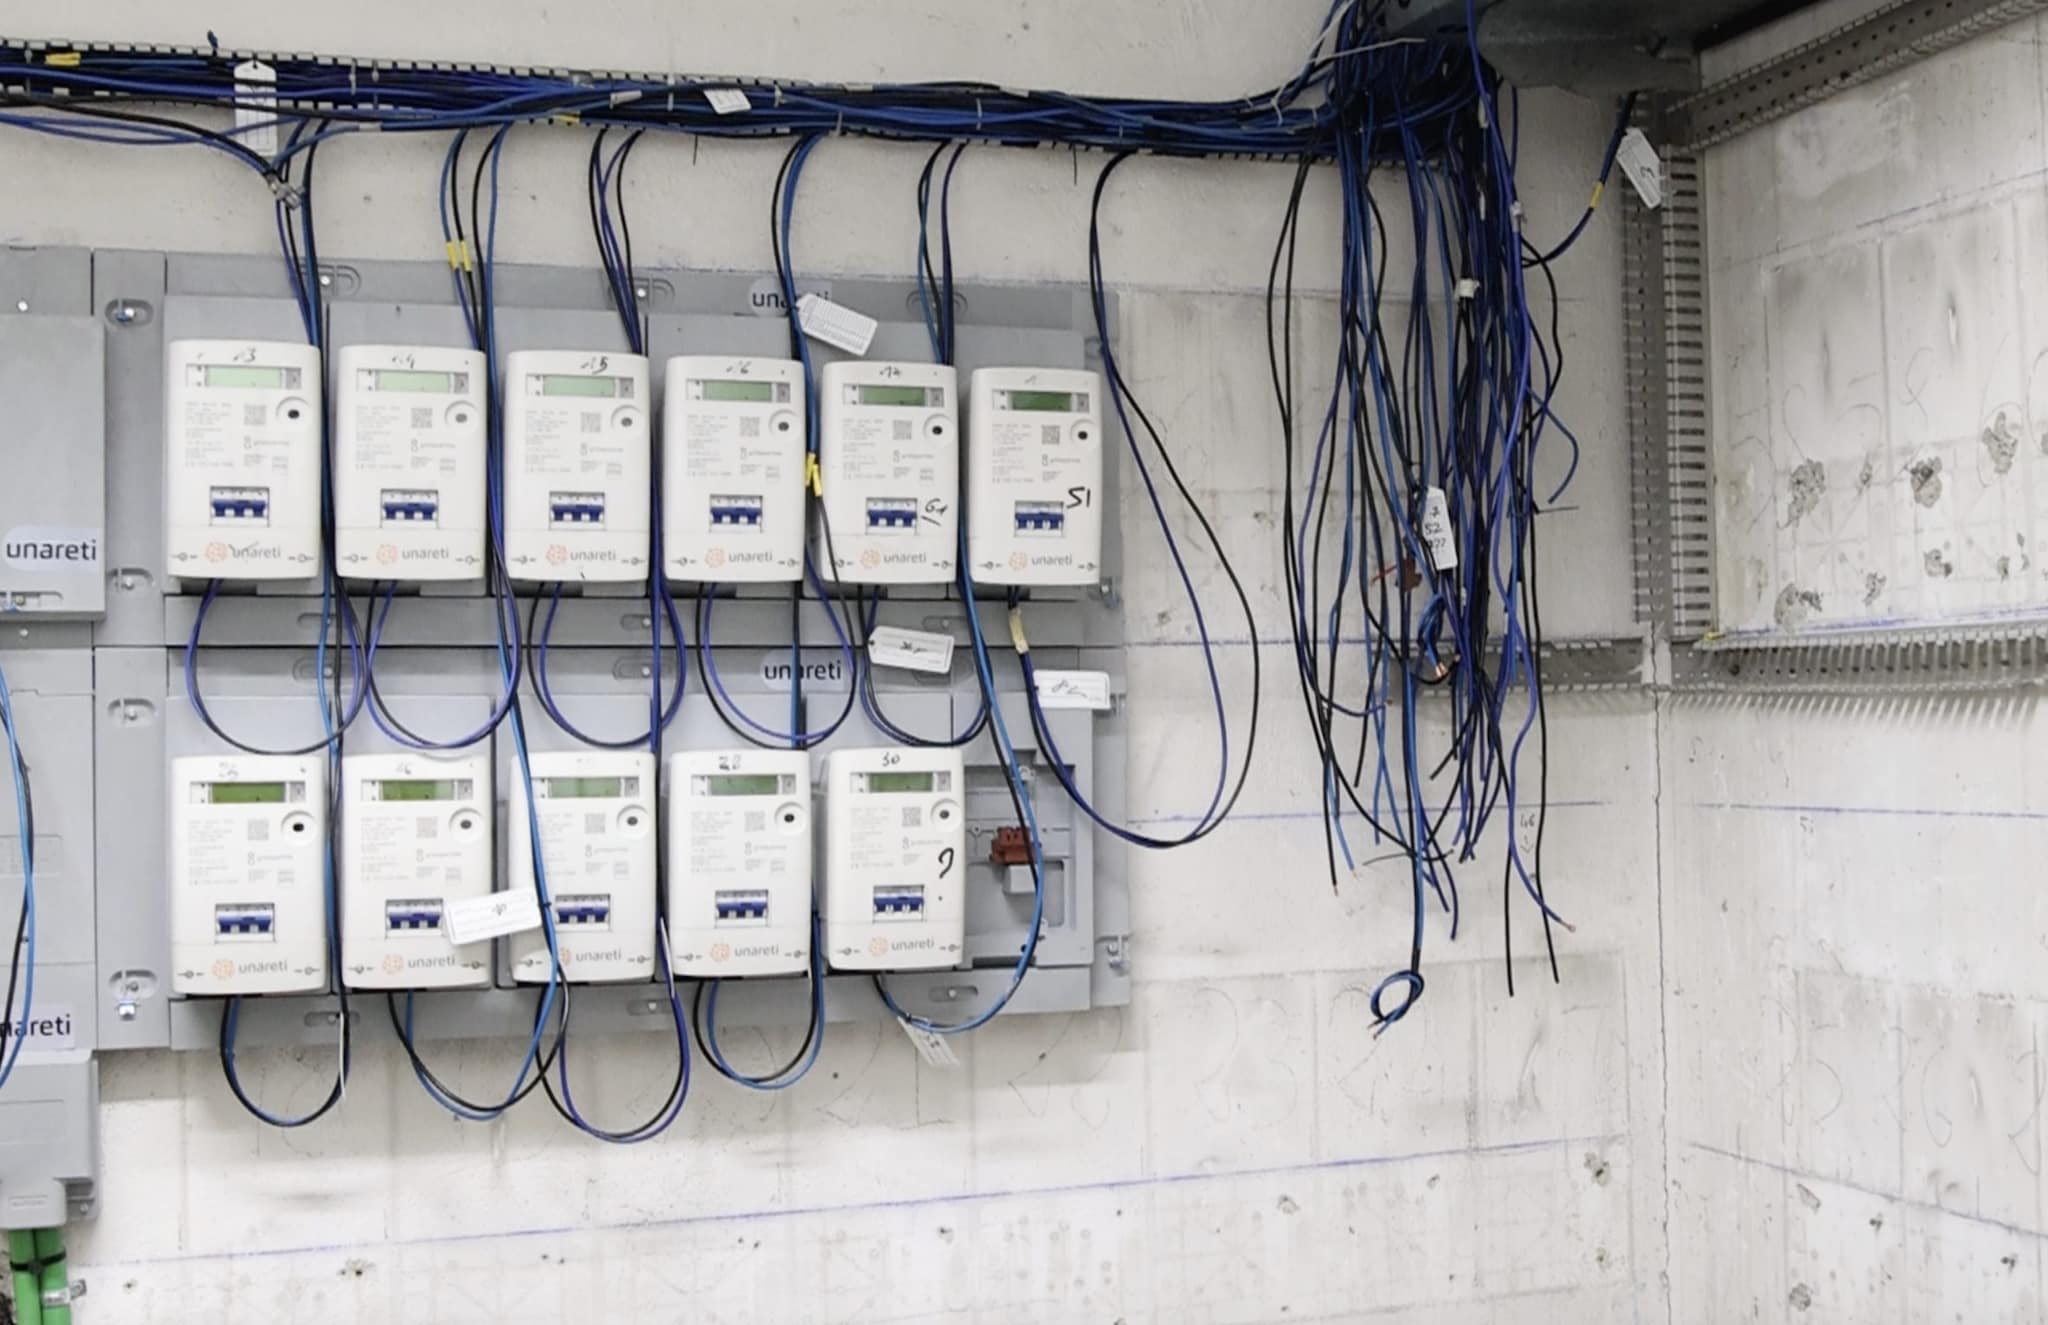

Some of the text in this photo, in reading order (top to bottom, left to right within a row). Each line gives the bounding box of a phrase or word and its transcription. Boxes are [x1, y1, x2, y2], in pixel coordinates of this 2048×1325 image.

[6, 539, 97, 561] unareti
[402, 545, 450, 560] unareti
[570, 548, 617, 563] unareti
[728, 548, 774, 565] unareti
[883, 550, 927, 565] unareti
[1031, 552, 1074, 567] unareti
[734, 942, 780, 959] unareti
[890, 936, 935, 952] unareti
[407, 954, 457, 970] unareti
[575, 947, 623, 963] unareti
[238, 958, 288, 974] unareti
